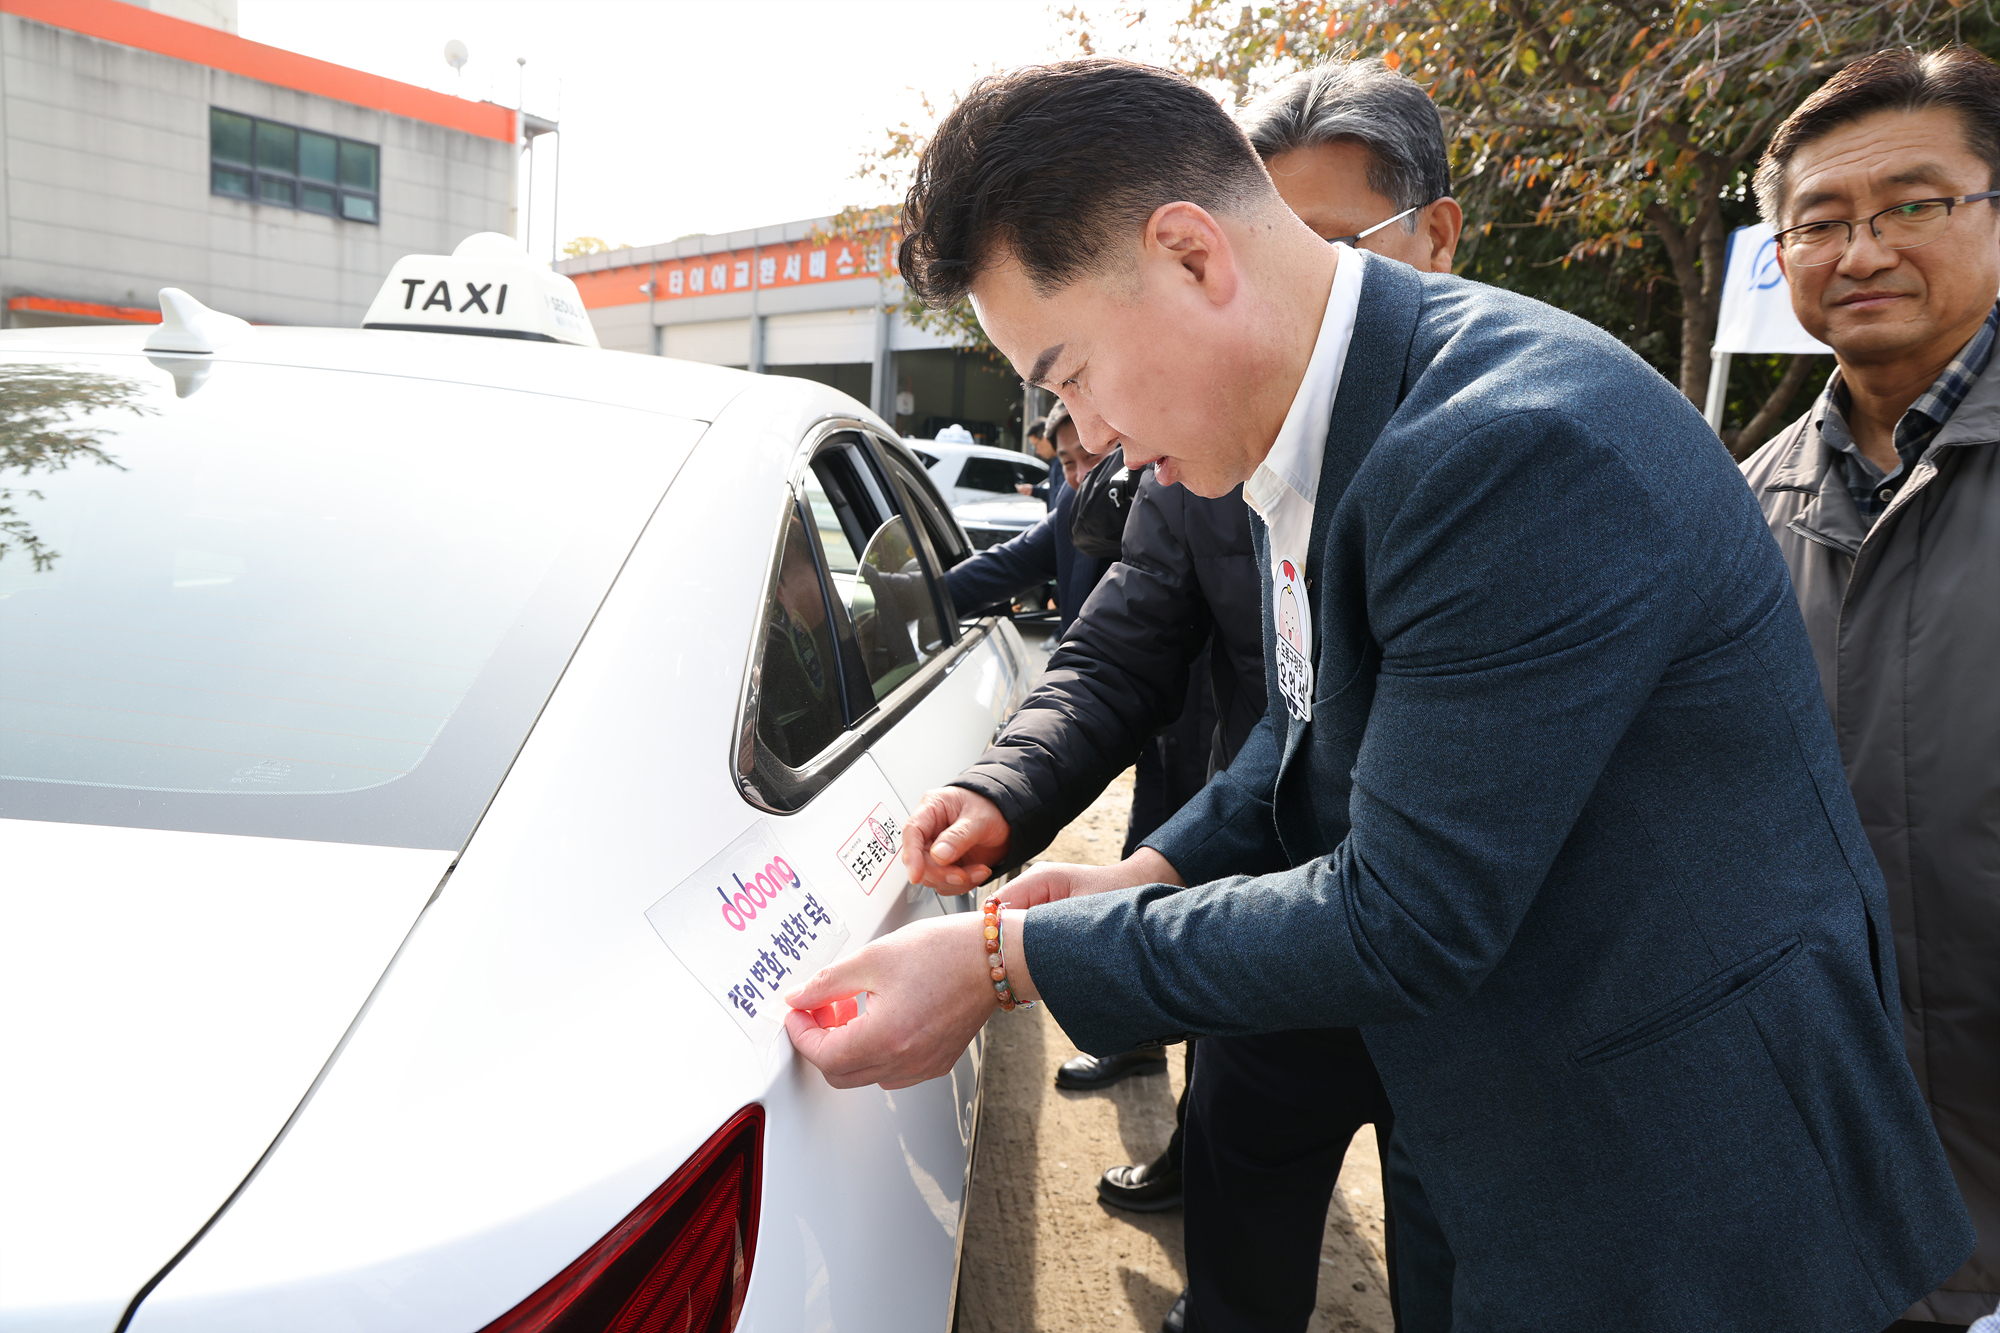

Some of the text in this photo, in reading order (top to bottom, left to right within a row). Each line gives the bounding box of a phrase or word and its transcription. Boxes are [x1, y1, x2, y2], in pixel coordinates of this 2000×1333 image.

[669, 239, 899, 296] 타이어교환서비스코
[402, 279, 508, 315] TAXI
[1280, 662, 1306, 712] 오언석
[716, 855, 801, 931] dobong
[852, 851, 876, 882] 도봉구
[728, 892, 832, 1018] 같이 변화, 행복한 도봉
